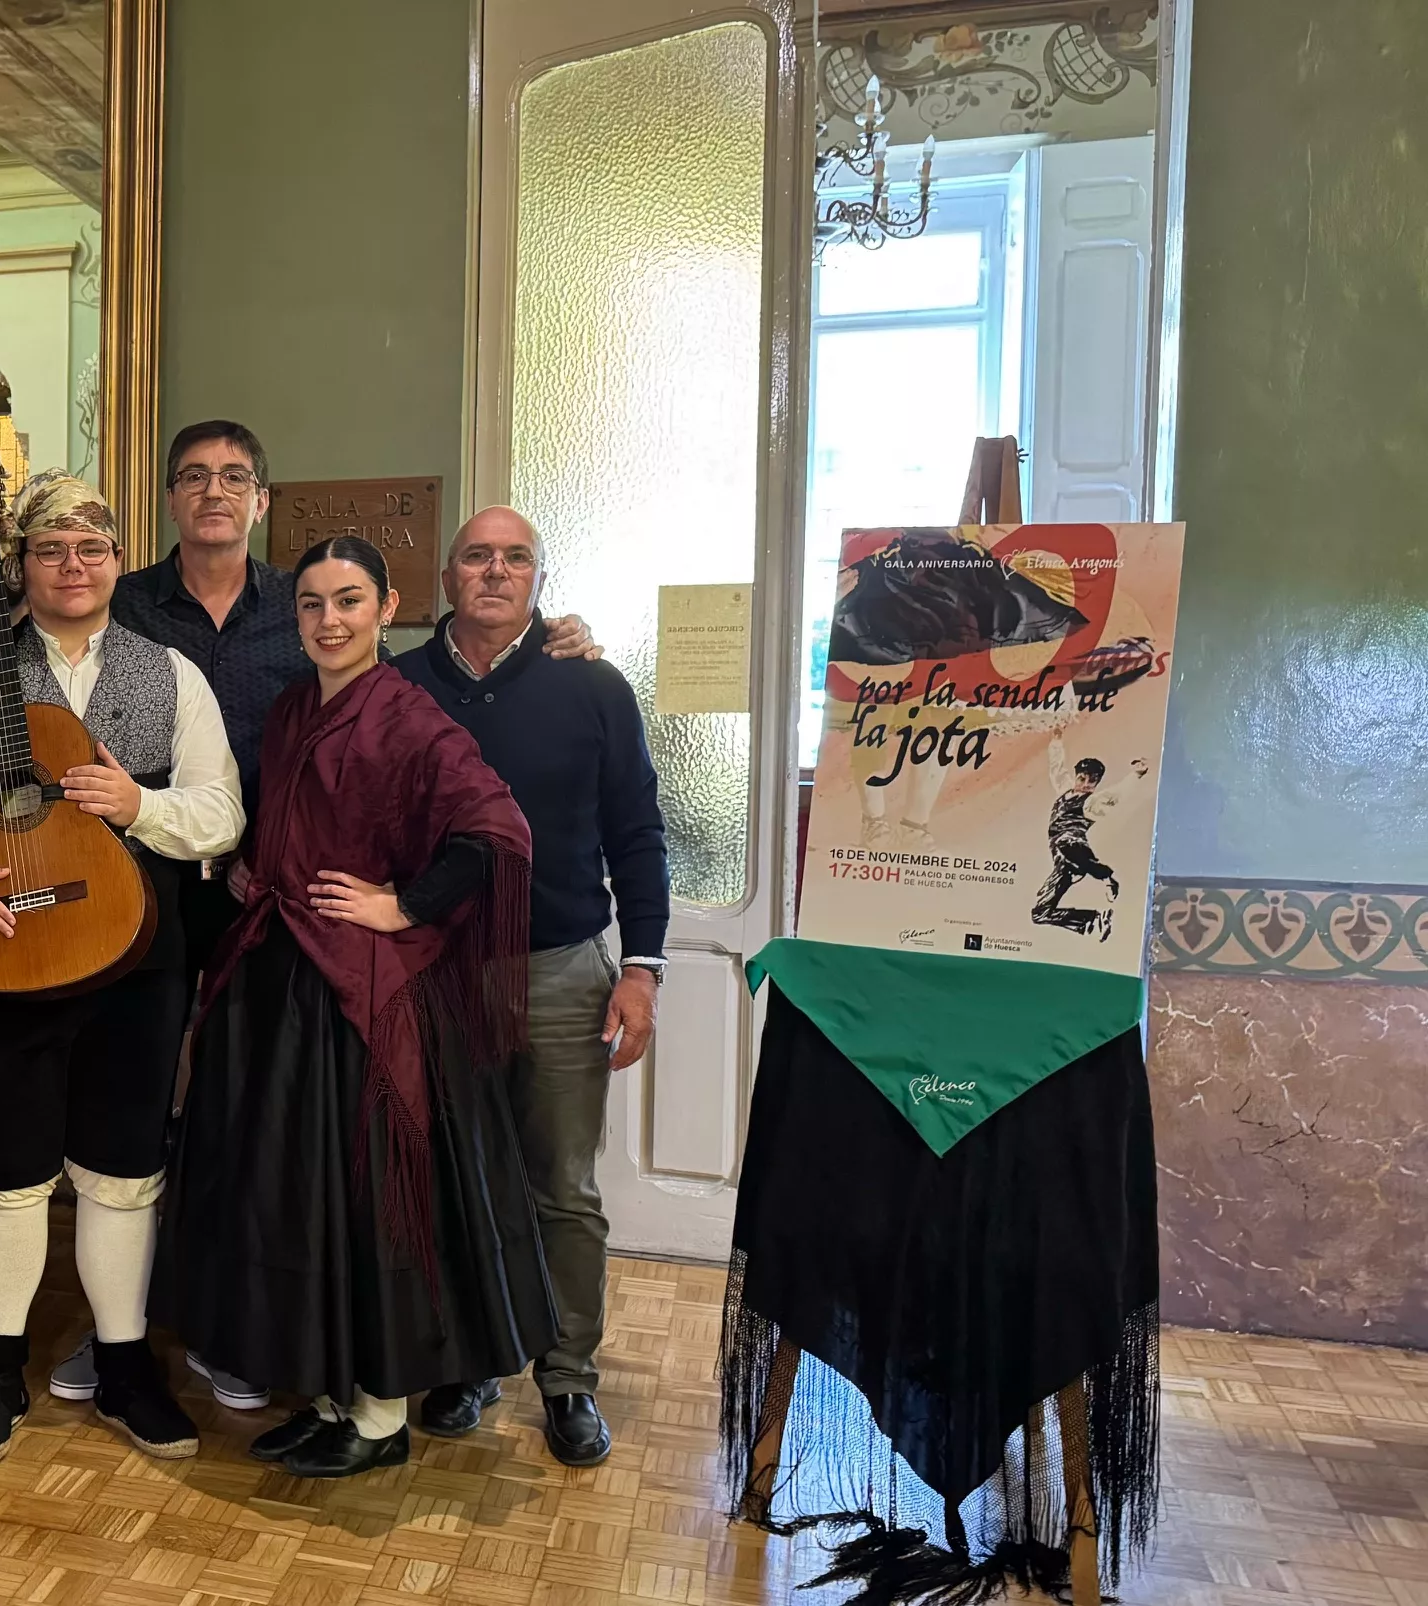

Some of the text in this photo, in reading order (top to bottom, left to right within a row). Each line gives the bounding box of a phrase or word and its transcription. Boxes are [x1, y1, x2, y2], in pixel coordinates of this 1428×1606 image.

[291, 492, 414, 519] SALA DE
[884, 559, 994, 569] GALA ANIVERSARIO
[1025, 552, 1124, 575] Elenco Aragonés
[847, 663, 1119, 724] por la senda de
[853, 705, 991, 787] la jota
[830, 849, 1017, 873] 16 DE NOVIEMBRE DEL 2024
[828, 862, 901, 883] 17:30H
[904, 869, 1015, 885] PALACIO DE CONGRESOS
[904, 878, 954, 889] DE HUESCA
[984, 937, 1033, 947] Ayuntamiento
[994, 944, 1021, 952] Huesca
